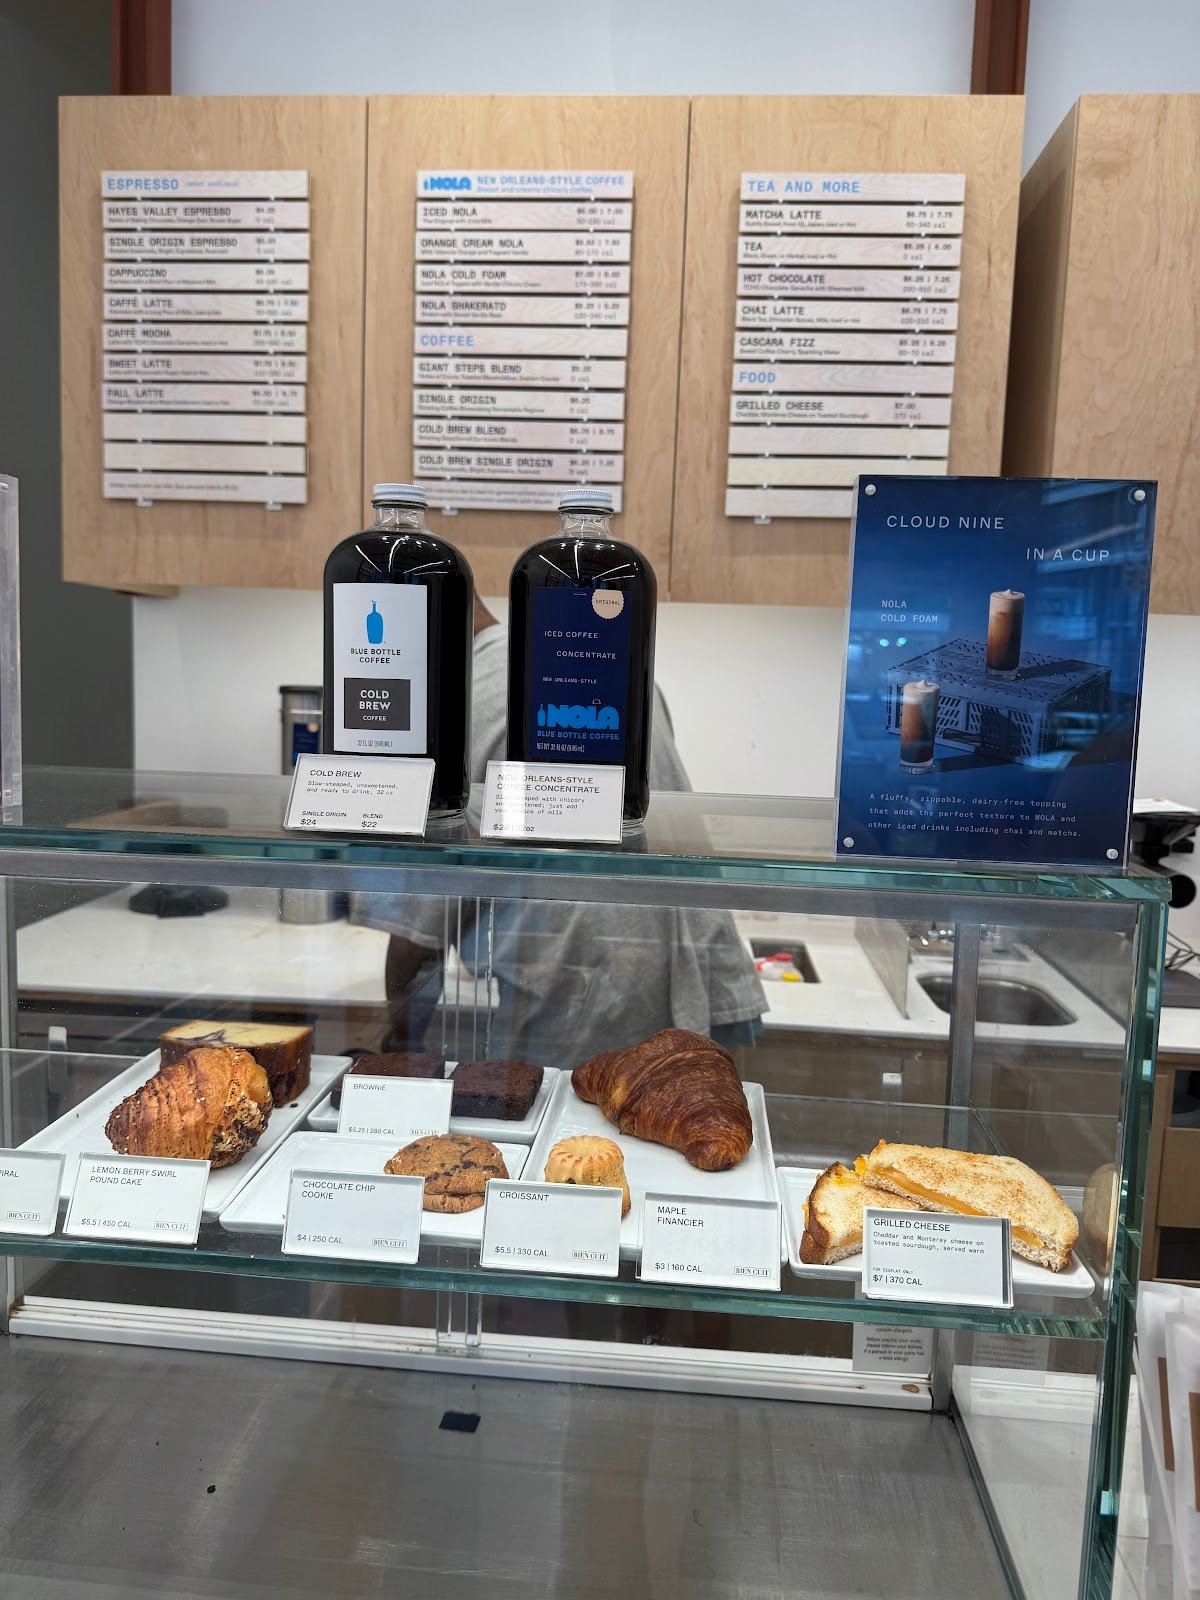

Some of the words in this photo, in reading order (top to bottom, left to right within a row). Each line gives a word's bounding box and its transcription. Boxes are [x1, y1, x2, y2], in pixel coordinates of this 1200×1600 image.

[107, 179, 179, 190] ESPRESSO
[501, 177, 581, 185] ORLEANS-STYLE
[586, 177, 624, 185] COFFEE
[748, 181, 774, 192] TEA
[785, 182, 813, 192] AND
[822, 182, 860, 193] MORE
[746, 211, 783, 219] MATCHA
[790, 211, 821, 219] LATTE
[500, 240, 524, 248] NOLA
[744, 242, 762, 250] TEA
[109, 269, 167, 277] CAPPUCCINO
[422, 271, 446, 279] NOLA
[452, 271, 476, 279] COLD
[482, 271, 506, 279] FOAM
[744, 275, 763, 283] HOT
[769, 275, 825, 283] CHOCOLATE
[144, 300, 173, 308] LATTE
[422, 302, 446, 310] NOLA
[452, 302, 506, 310] SHAKERATO
[774, 307, 805, 315] LATTE
[142, 329, 171, 337] MOCHA
[420, 335, 474, 346] COFFEE
[740, 338, 784, 346] CASCARA
[790, 339, 815, 347] FIZZ
[109, 360, 136, 368] SWEET
[144, 360, 172, 368] LATTE
[419, 364, 448, 372] GIANT
[491, 365, 521, 373] BLEND
[739, 372, 776, 383] FOOD
[136, 390, 164, 398] LATTE
[418, 395, 454, 403] SINGLE
[460, 396, 496, 404] ORIGIN
[786, 402, 824, 410] CHEESE
[449, 426, 471, 434] BREW
[476, 427, 506, 435] BLEND
[449, 457, 471, 465] BREW
[477, 458, 512, 466] SINGLE
[517, 459, 553, 467] ORIGIN
[887, 516, 950, 528] CLOUD
[959, 517, 1004, 529] NINE
[1026, 548, 1044, 560] IN
[1053, 550, 1063, 560] A
[1072, 550, 1109, 562] CUP
[882, 600, 907, 608] NOLA
[913, 615, 937, 623] FOAM
[557, 651, 616, 659] CONCENTRATE
[360, 690, 389, 699] COLD
[359, 701, 391, 710] BREW
[535, 785, 599, 793] CONCENTRATE
[880, 794, 914, 802] fluffy,
[920, 795, 966, 805] sippable,
[972, 797, 1024, 807] dairy-free
[1030, 800, 1066, 809] topping
[955, 825, 999, 834] including
[1047, 829, 1081, 837] matcha.
[92, 1166, 120, 1174] LEMON
[123, 1168, 149, 1176] BERRY
[303, 1181, 353, 1190] CHOCOLATE
[356, 1184, 375, 1192] CHIP
[302, 1191, 334, 1199] COOKIE
[500, 1191, 549, 1201] CROISSANT
[658, 1207, 686, 1215] MAPLE
[81, 1218, 96, 1226] $5.5
[117, 1220, 131, 1228] CAL
[658, 1217, 704, 1227] FINANCIER
[874, 1219, 911, 1228] GRILLED
[914, 1222, 950, 1231] CHEESE
[917, 1235, 946, 1244] Monterey
[495, 1246, 511, 1254] $5.5
[518, 1248, 531, 1256] 330
[903, 1242, 939, 1251] sourdough,
[655, 1262, 665, 1270] $3
[907, 1278, 922, 1286] CAL
